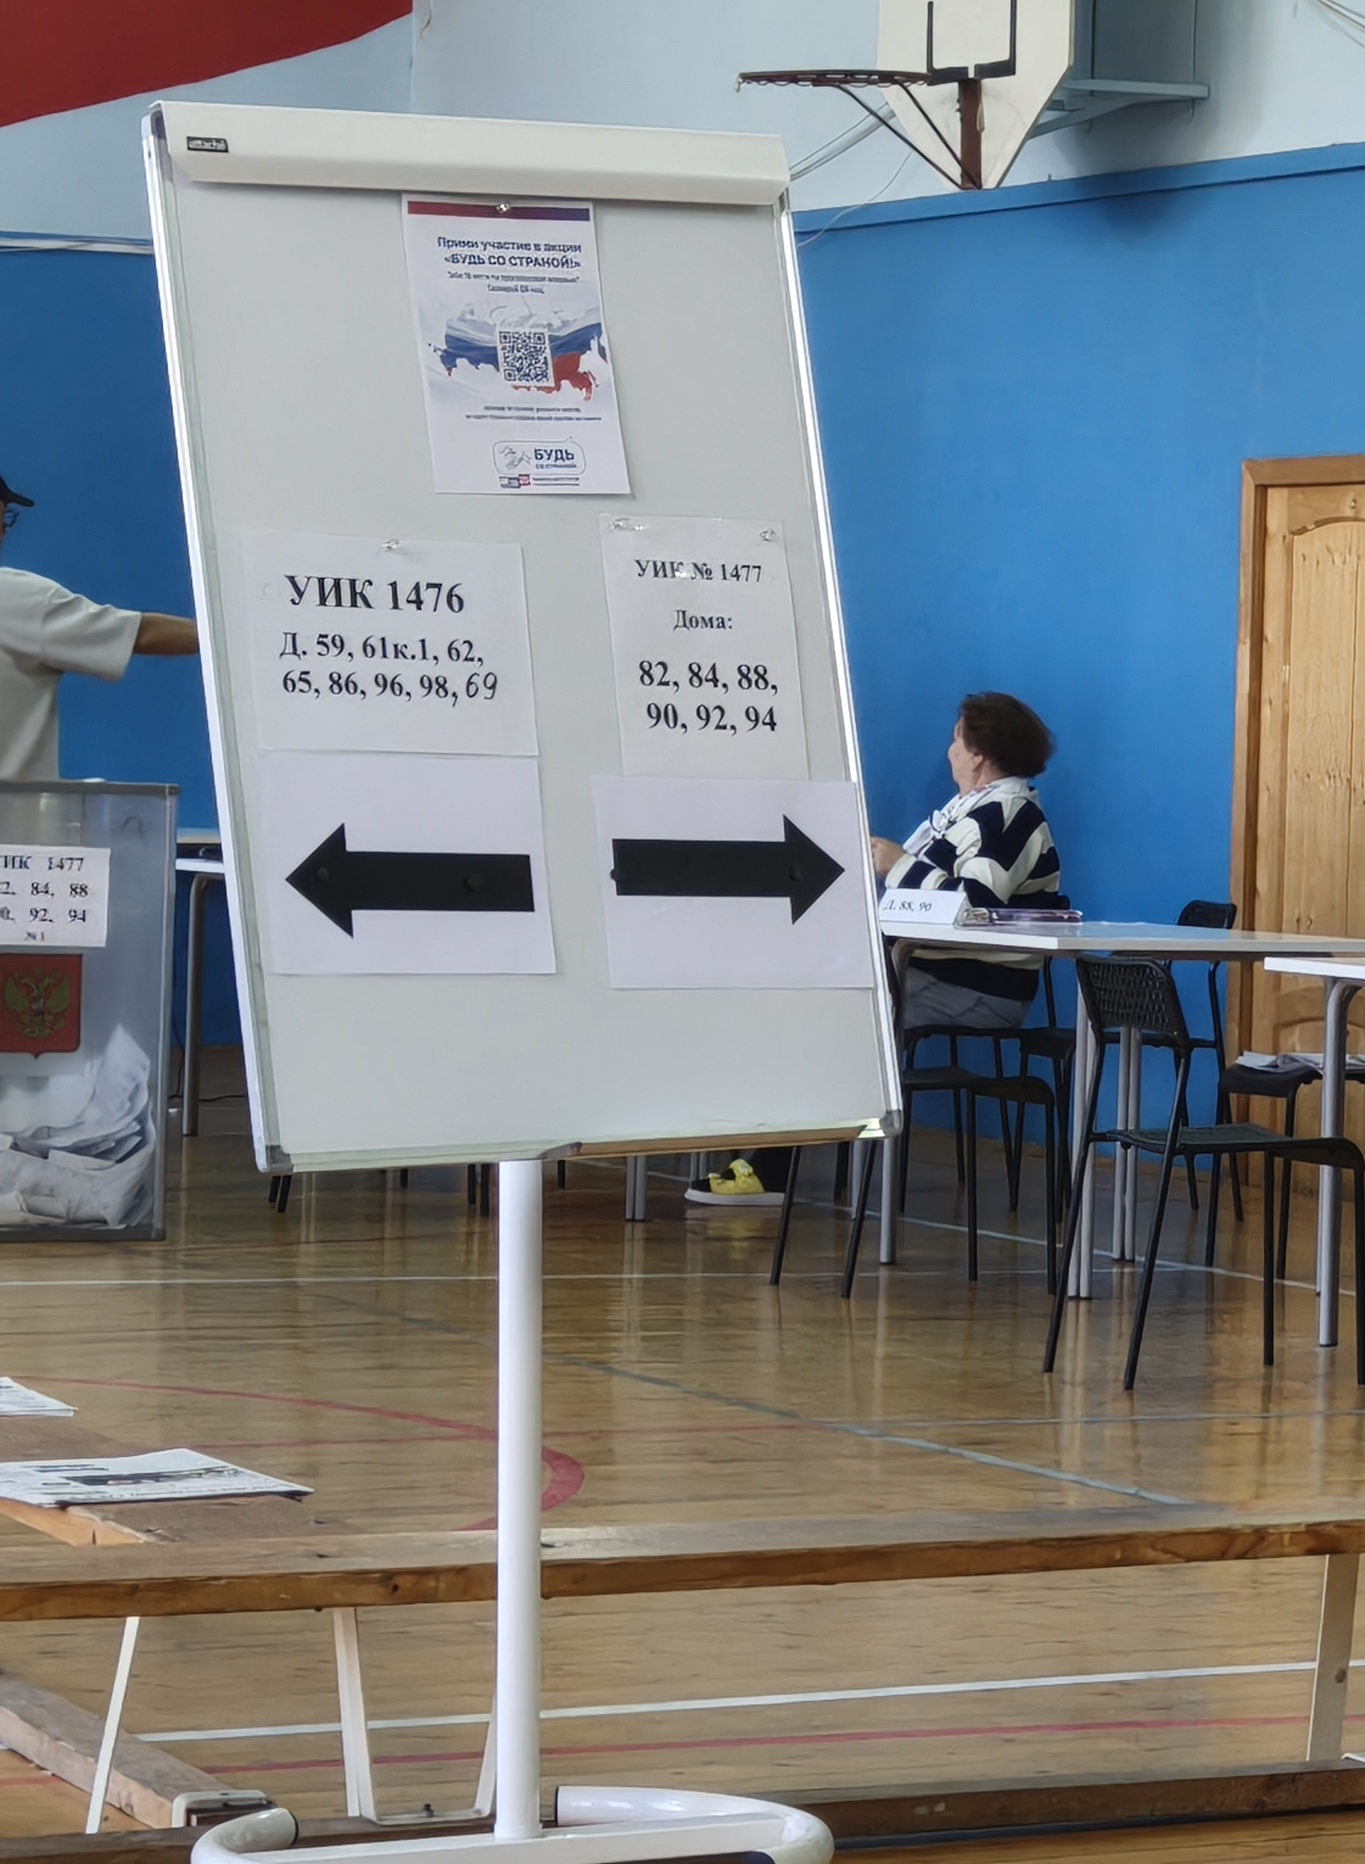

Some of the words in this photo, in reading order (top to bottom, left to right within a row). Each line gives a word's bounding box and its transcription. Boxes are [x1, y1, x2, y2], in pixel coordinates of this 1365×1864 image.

[488, 254, 507, 267] СО
[534, 448, 575, 463] БУДЬ
[690, 562, 713, 581] №
[720, 563, 763, 583] 1477
[283, 574, 376, 609] УИК
[386, 580, 466, 614] 1476
[673, 609, 734, 632] Дома:
[278, 631, 308, 661] Д.
[315, 633, 355, 663] 59,
[361, 636, 440, 667] 61к.1,
[446, 638, 485, 667] 62,
[281, 669, 322, 700] 65,
[327, 671, 367, 701] 86,
[373, 673, 413, 703] 96,
[418, 674, 459, 708] 98,
[465, 671, 499, 701] 69
[638, 659, 680, 694] 82,
[687, 661, 729, 694] 84,
[736, 663, 779, 696] 88,
[646, 702, 689, 735] 90,
[695, 703, 738, 737] 92,
[744, 705, 778, 733] 94
[0, 854, 32, 870] ИК
[69, 882, 89, 898] 88
